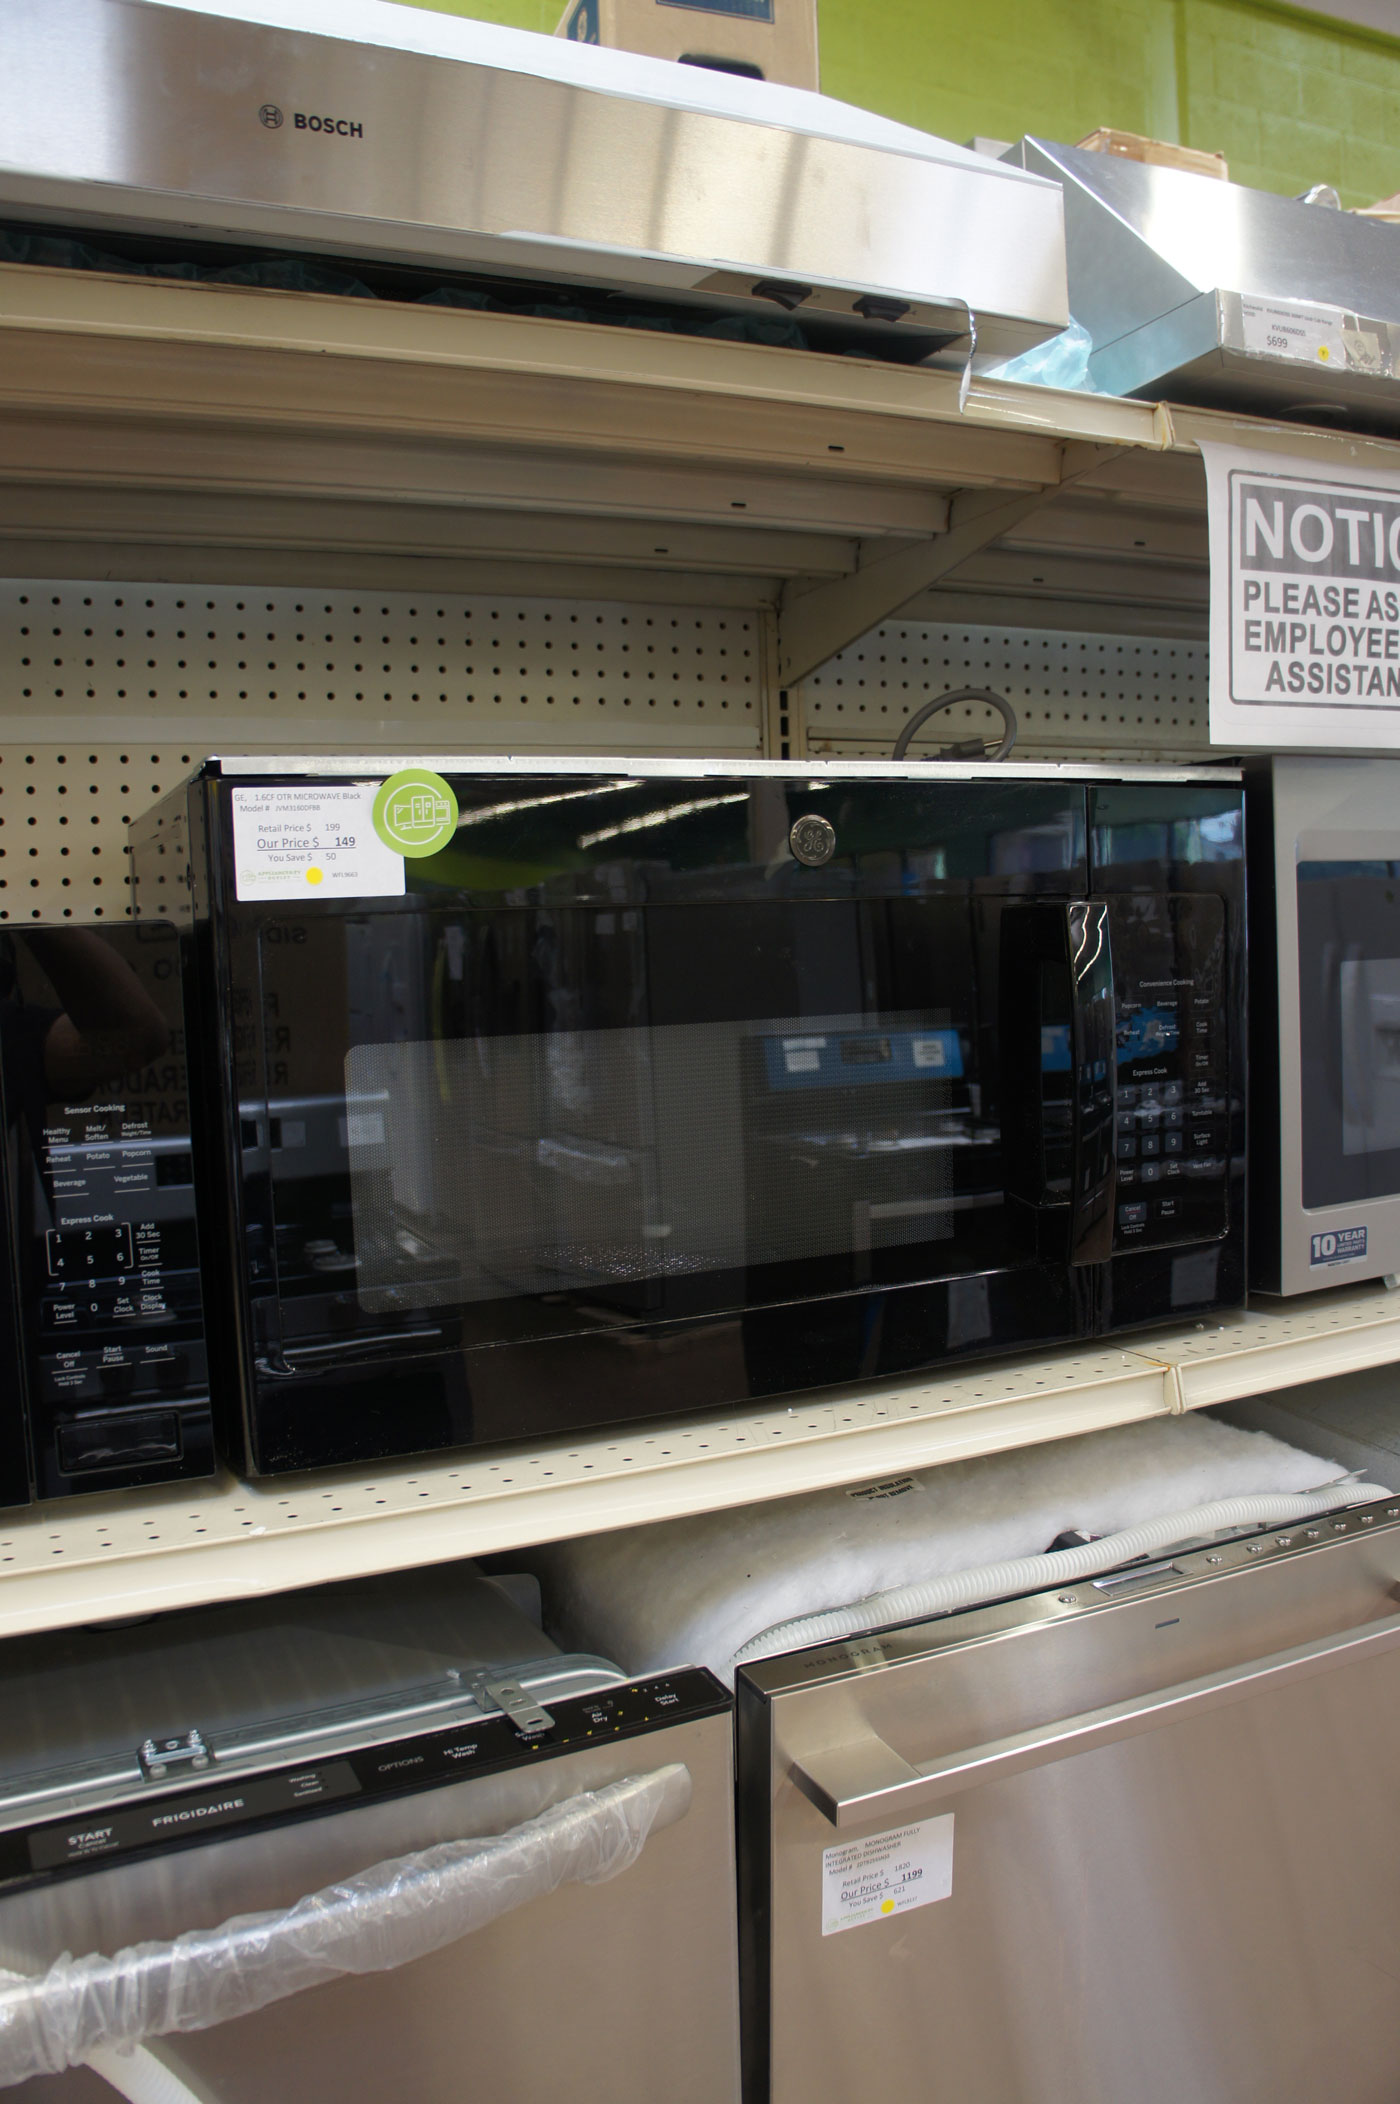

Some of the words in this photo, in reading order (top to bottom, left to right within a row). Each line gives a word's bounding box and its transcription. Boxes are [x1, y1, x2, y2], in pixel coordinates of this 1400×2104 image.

[294, 113, 363, 138] BOSCH
[1267, 336, 1288, 348] $699
[1246, 498, 1400, 572] NOTI
[1244, 580, 1360, 619] PLEASE
[1244, 619, 1399, 660] EMPLOYEE
[235, 794, 247, 802] GE,
[284, 824, 304, 832] Price
[307, 824, 312, 832] $
[325, 823, 340, 831] 199
[257, 839, 278, 849] Our
[282, 839, 309, 848] Price
[313, 837, 319, 848] $
[335, 837, 356, 847] 149
[268, 854, 284, 862] You
[286, 853, 305, 861] Save
[307, 853, 312, 861] $
[1124, 1090, 1128, 1098] 1
[1148, 1088, 1152, 1096] 2
[64, 1106, 91, 1115] Sensor
[93, 1104, 125, 1113] Cooking
[86, 1124, 106, 1133] Melt/
[122, 1122, 148, 1130] Defrost
[43, 1128, 71, 1136] Healthy
[85, 1133, 109, 1141] Soften
[1148, 1141, 1152, 1149] 8
[1171, 1138, 1176, 1146] 9
[86, 1152, 110, 1160] Potato
[122, 1150, 152, 1158] Popcorn
[46, 1155, 72, 1163] Reheat
[114, 1173, 148, 1182] Vegetable
[53, 1179, 86, 1188] Beverage
[61, 1217, 92, 1226] Express
[93, 1214, 114, 1222] Cook
[85, 1231, 92, 1240] 2
[115, 1229, 122, 1238] 3
[146, 1230, 161, 1238] Sec
[1338, 1229, 1365, 1242] YEAR
[56, 1234, 62, 1243] 1
[1313, 1234, 1336, 1257] 10
[87, 1255, 94, 1264] 5
[116, 1253, 124, 1261] 6
[57, 1258, 65, 1267] 4
[141, 1269, 160, 1277] Cook
[88, 1279, 96, 1288] 8
[118, 1276, 125, 1285] 9
[142, 1277, 160, 1285] Time
[59, 1282, 66, 1292] 7
[116, 1297, 129, 1305] Set
[142, 1294, 162, 1302] Clock
[53, 1303, 75, 1312] Power
[90, 1303, 98, 1312] 0
[114, 1305, 134, 1313] Clock
[140, 1302, 166, 1310] Display
[55, 1312, 74, 1320] Level
[103, 1346, 121, 1354] Start
[145, 1345, 168, 1353] Sound
[56, 1351, 81, 1360] Cancel
[103, 1355, 124, 1363] Pause
[803, 1643, 893, 1669] MONOGRAM
[659, 1697, 679, 1706] Start
[454, 1743, 478, 1753] Temp
[452, 1750, 476, 1759] Wash
[378, 1756, 424, 1772] OPTIONS
[152, 1799, 245, 1828] FRIGIDAIRE
[68, 1827, 113, 1846] START
[864, 1831, 902, 1848] MONOGRAM
[903, 1827, 920, 1837] FULLY
[825, 1853, 862, 1867] INTEGRATED
[863, 1841, 901, 1857] DISHWASHER
[829, 1867, 848, 1875] Model
[842, 1878, 861, 1887] Retail
[862, 1872, 881, 1882] Price
[880, 1870, 884, 1878] $
[894, 1862, 910, 1872] 1820
[841, 1889, 857, 1900] Our
[860, 1882, 881, 1895] Price
[884, 1879, 890, 1887] $
[902, 1868, 922, 1881] 1199
[849, 1899, 862, 1909] You
[863, 1895, 878, 1904] Save
[879, 1892, 883, 1900] $
[893, 1886, 905, 1895] 621
